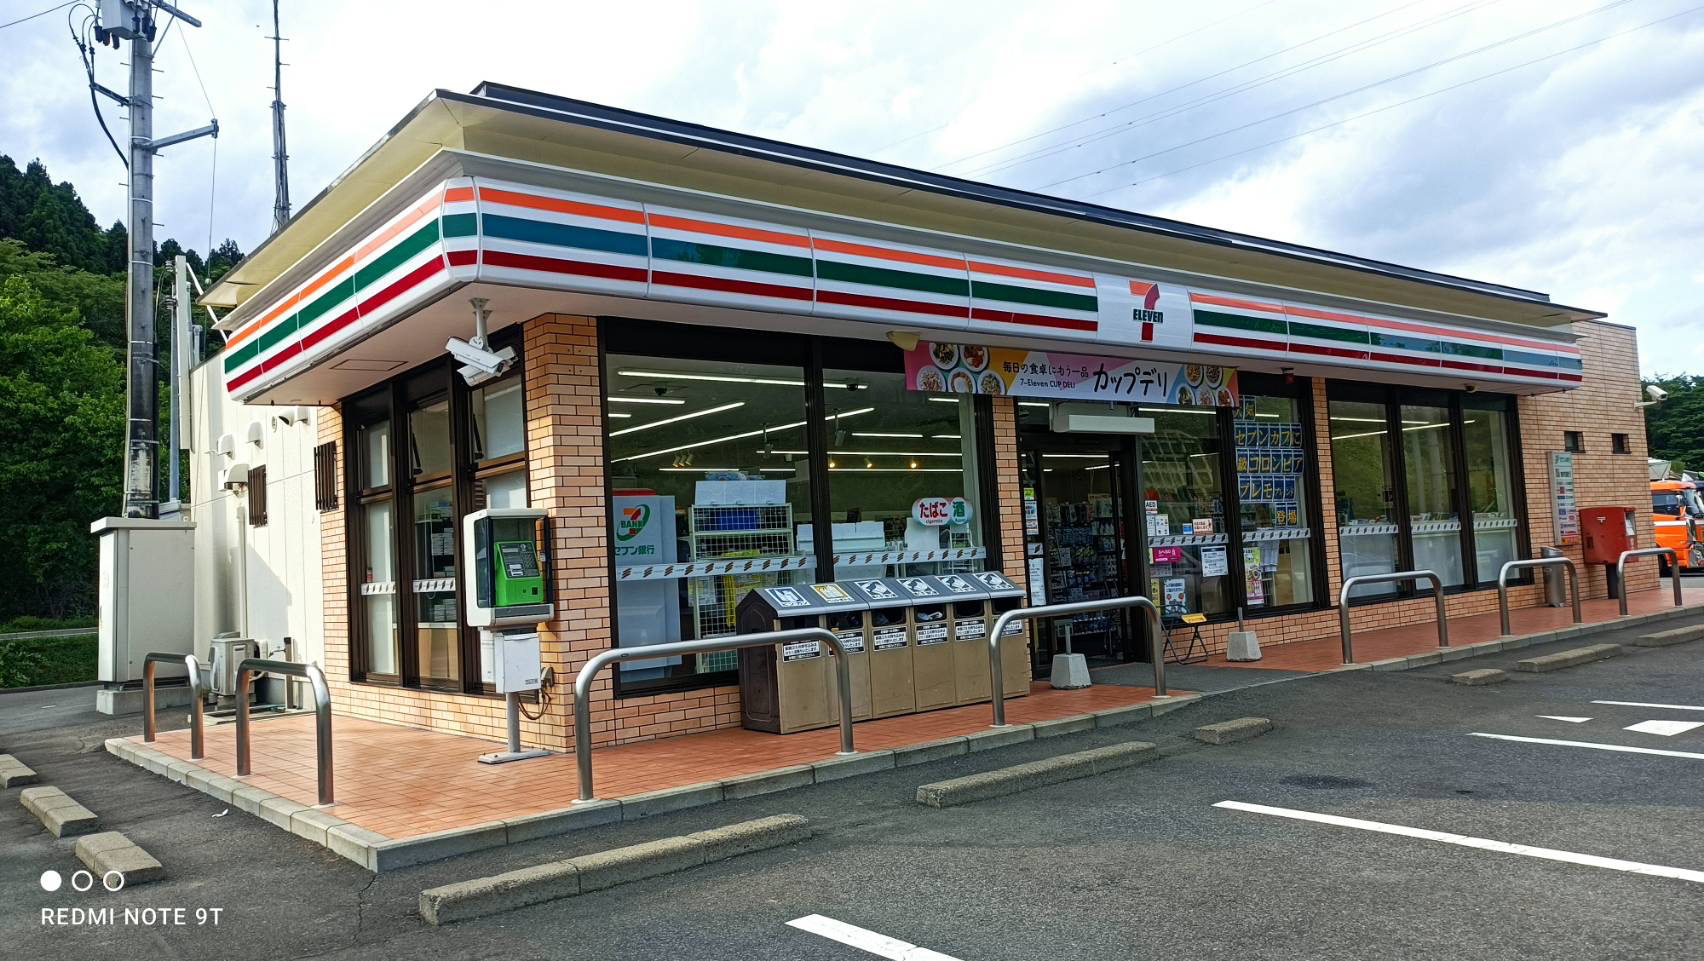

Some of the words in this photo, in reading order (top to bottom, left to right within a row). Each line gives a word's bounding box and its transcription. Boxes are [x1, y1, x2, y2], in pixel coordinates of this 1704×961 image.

[1003, 361, 1088, 378] 毎日の食卓にもう一品
[1020, 378, 1048, 388] 7-Eleven
[1093, 363, 1168, 397] カップデリ
[919, 501, 948, 518] たばこ
[953, 501, 965, 518] 酒
